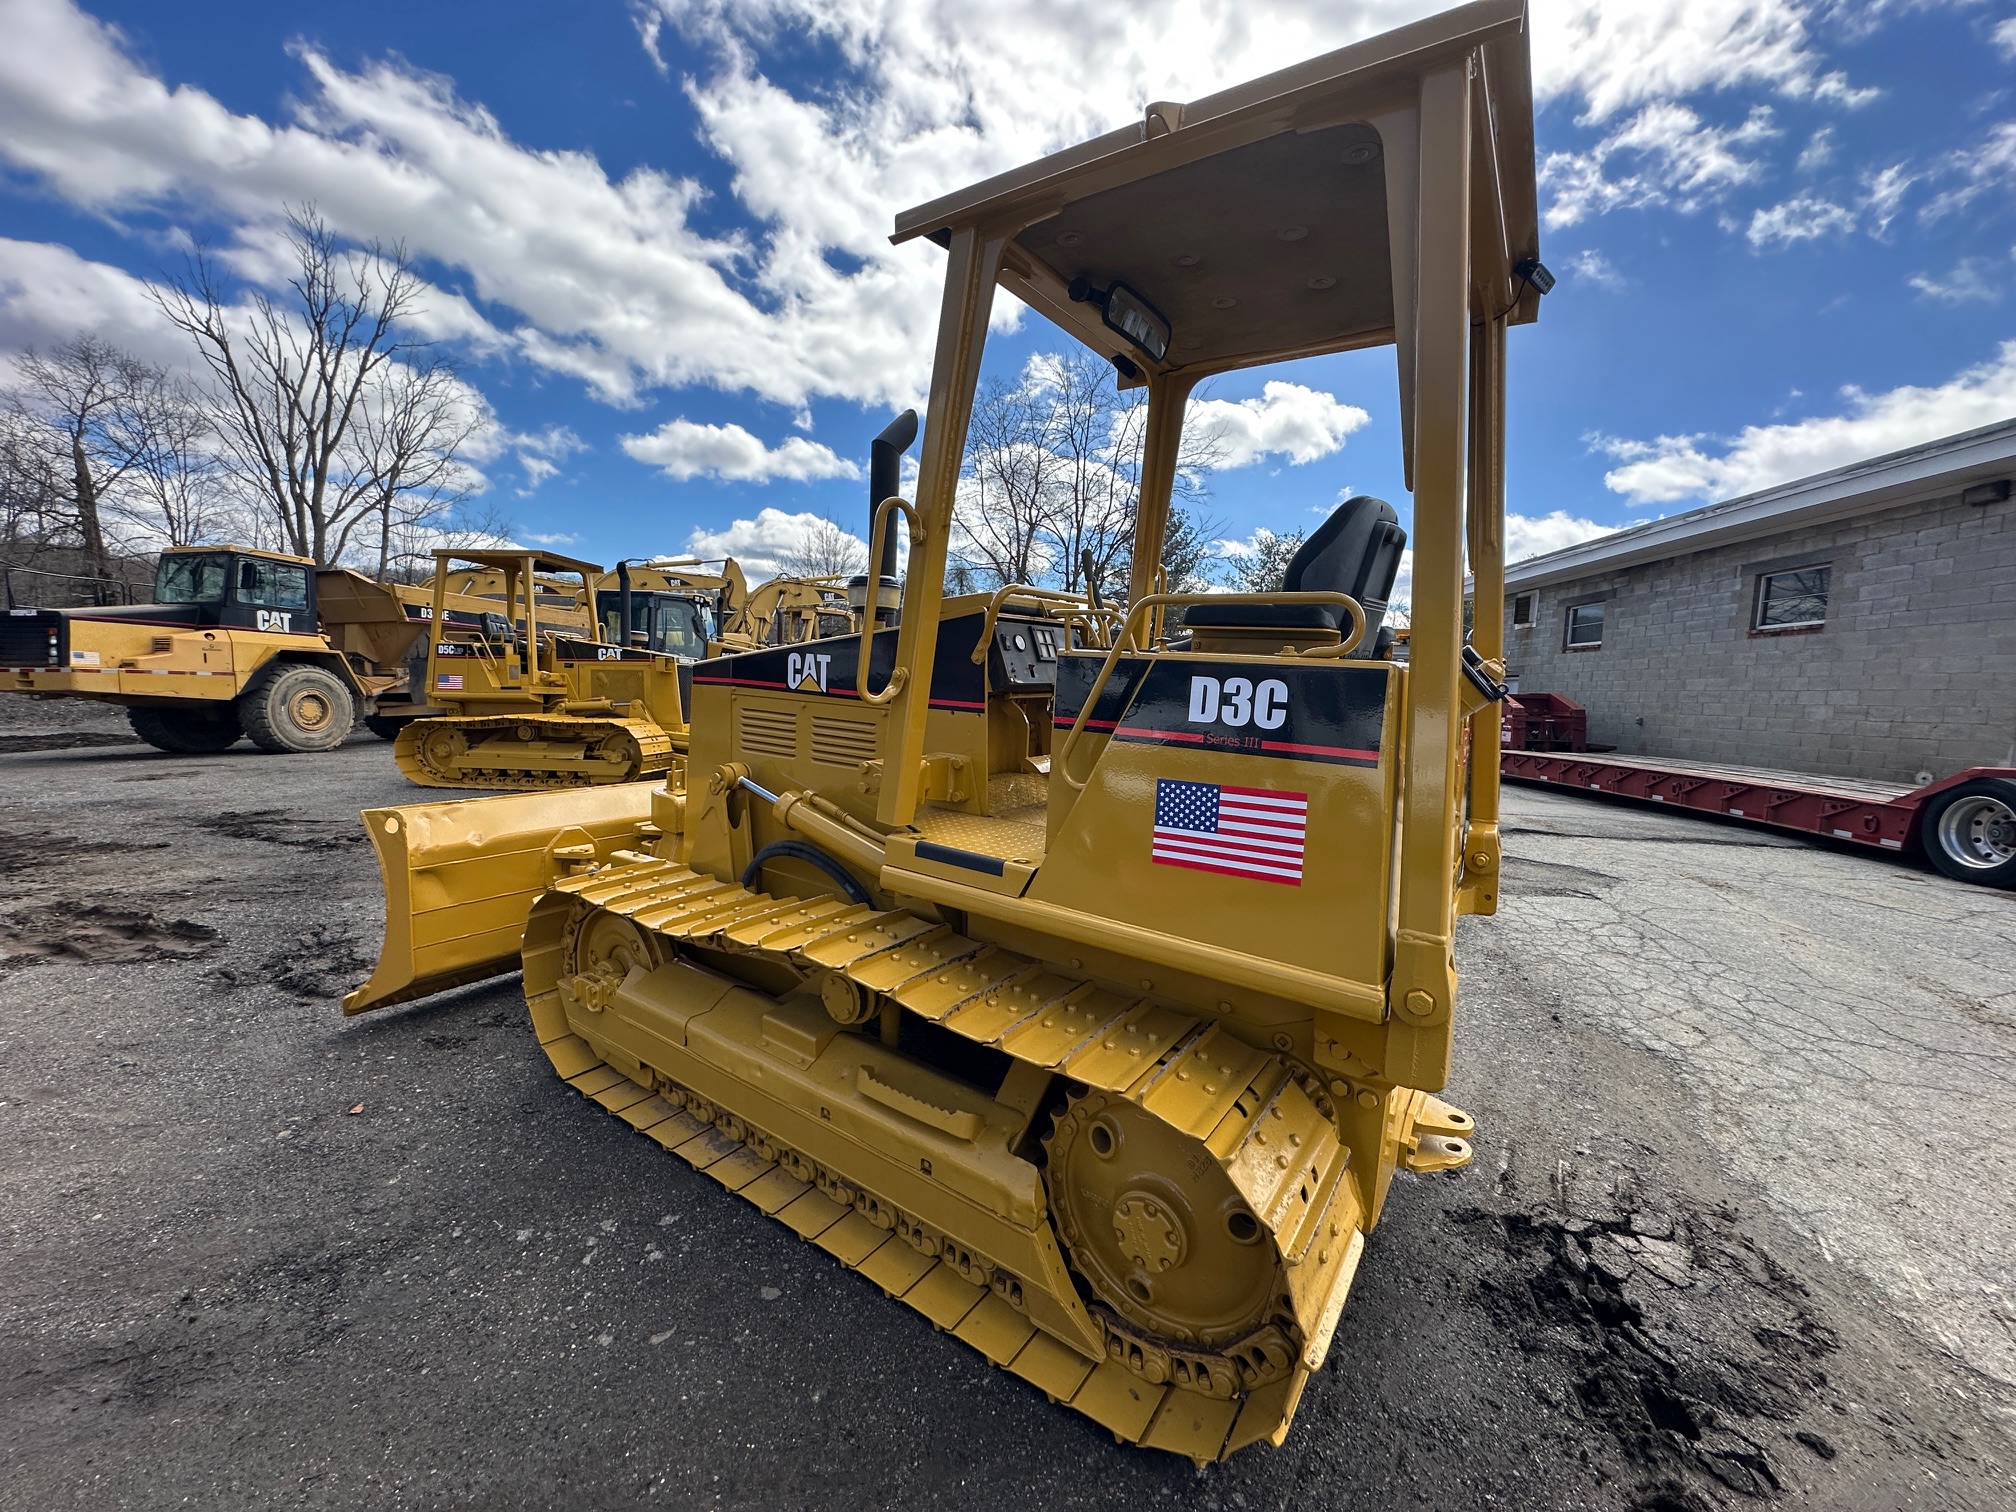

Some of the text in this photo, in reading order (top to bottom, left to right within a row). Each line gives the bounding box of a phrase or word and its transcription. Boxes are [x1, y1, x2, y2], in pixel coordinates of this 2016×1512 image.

[824, 593, 834, 601] CAT
[421, 607, 450, 620] D3E
[256, 609, 292, 633] CAT
[438, 645, 455, 654] D5C
[597, 648, 623, 661] CAT
[787, 652, 831, 693] CAT
[1188, 675, 1289, 730] D3C
[1206, 733, 1260, 749] Series III
